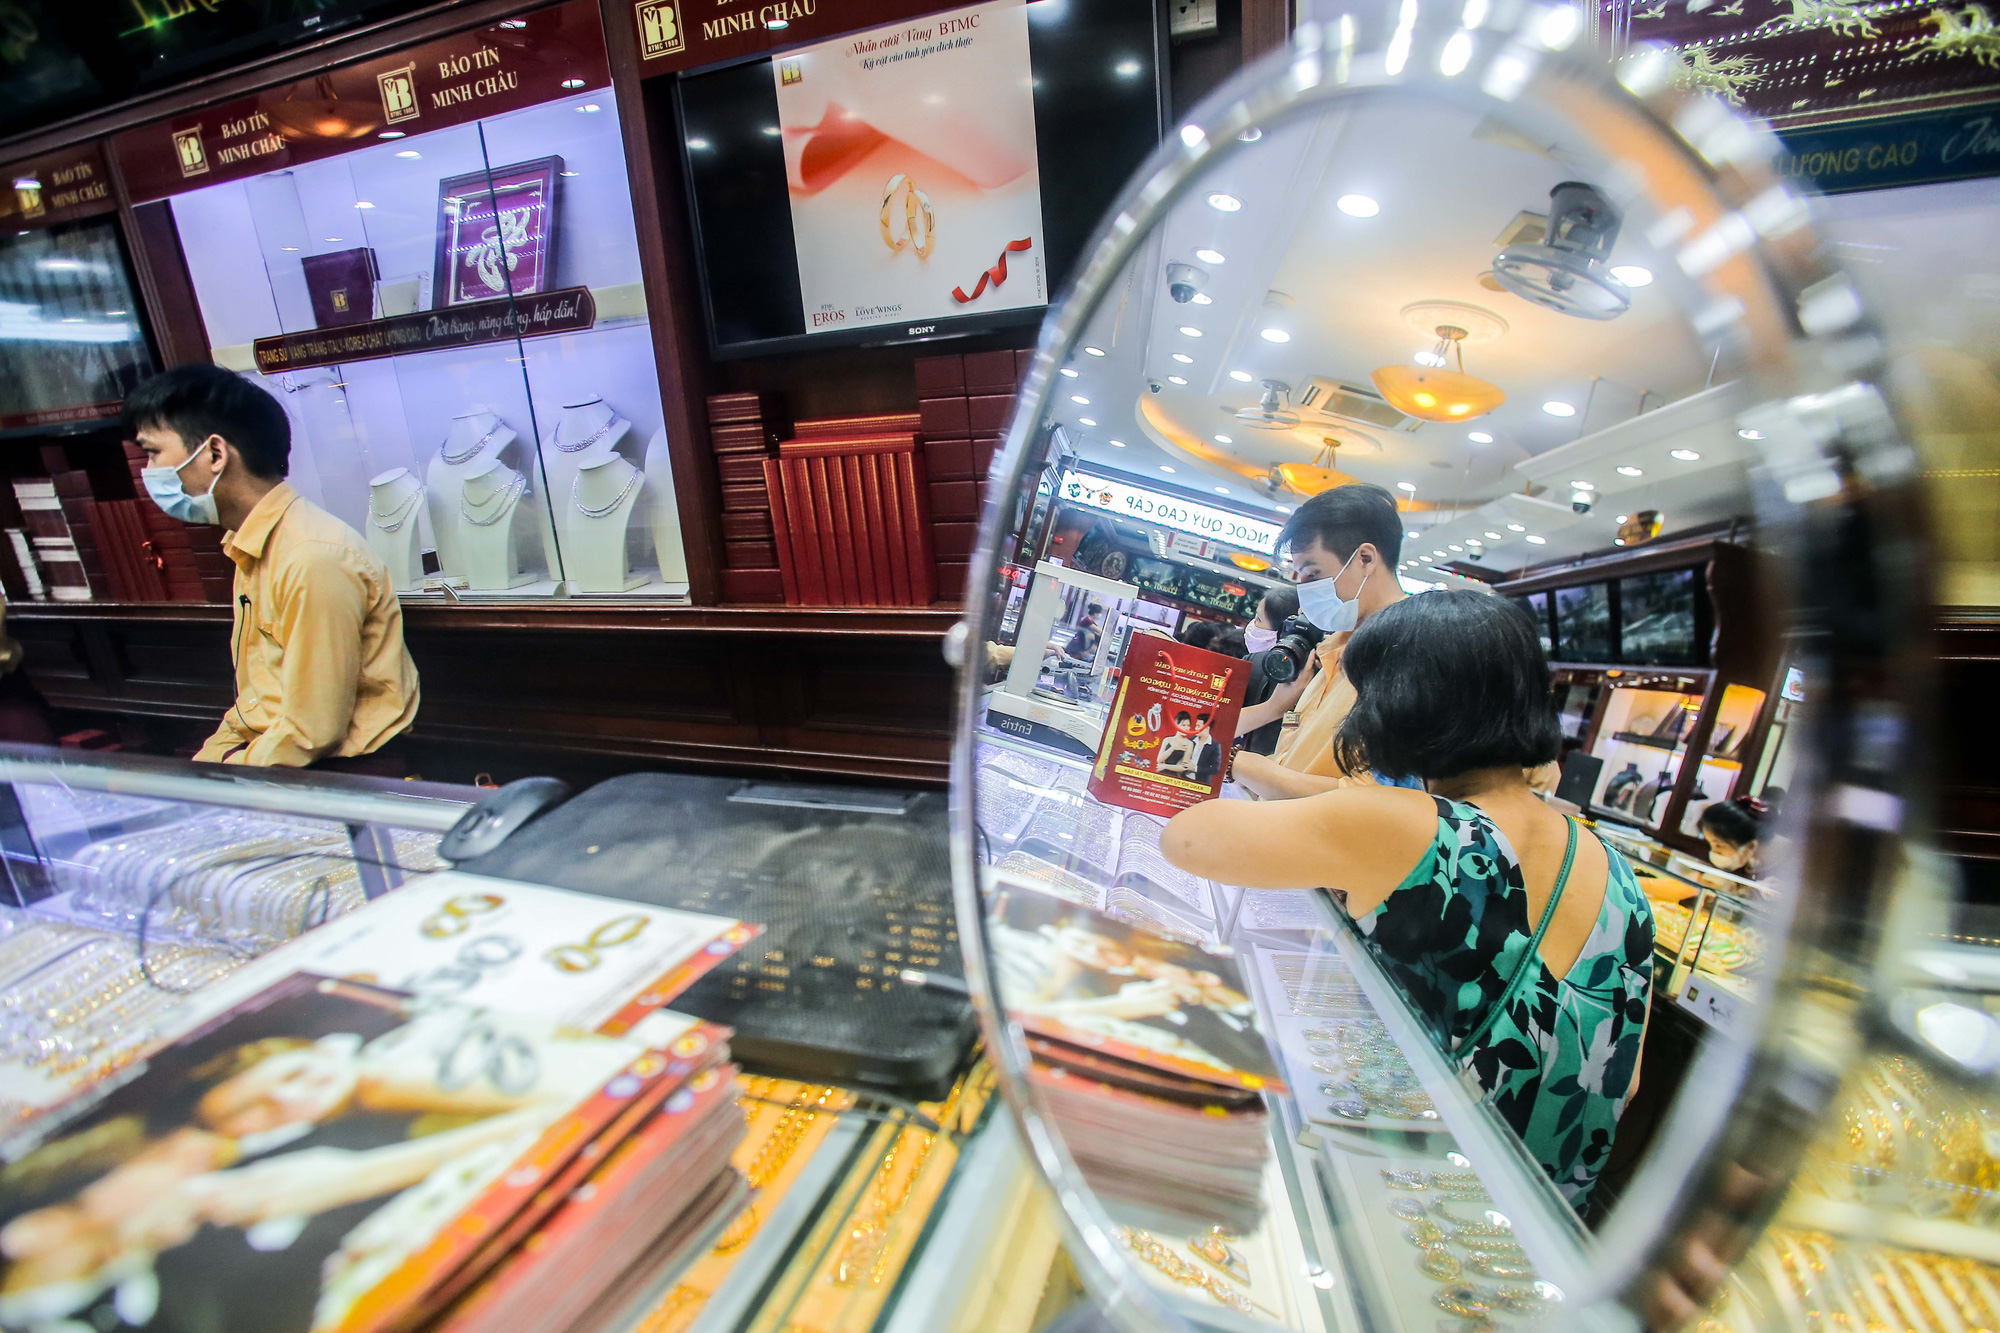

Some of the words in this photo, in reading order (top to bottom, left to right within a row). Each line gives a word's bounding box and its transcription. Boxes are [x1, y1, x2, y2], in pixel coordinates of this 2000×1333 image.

[702, 10, 756, 41] MINH
[939, 14, 980, 36] BTMC
[438, 54, 471, 79] BẢO
[472, 45, 500, 67] TÍN
[431, 83, 473, 109] MINH
[474, 71, 519, 97] CHÂU
[221, 118, 247, 139] BẢO
[248, 111, 270, 131] TÍN
[217, 144, 251, 165] MINH
[251, 132, 286, 157] CHÂU
[1867, 141, 1918, 170] CAO
[52, 190, 78, 208] MINH
[812, 310, 845, 327] EROS
[855, 307, 875, 316] LOVE
[877, 304, 902, 314] WINGS
[258, 348, 279, 364] TRANG
[406, 326, 421, 343] CAO
[908, 326, 935, 335] SONY
